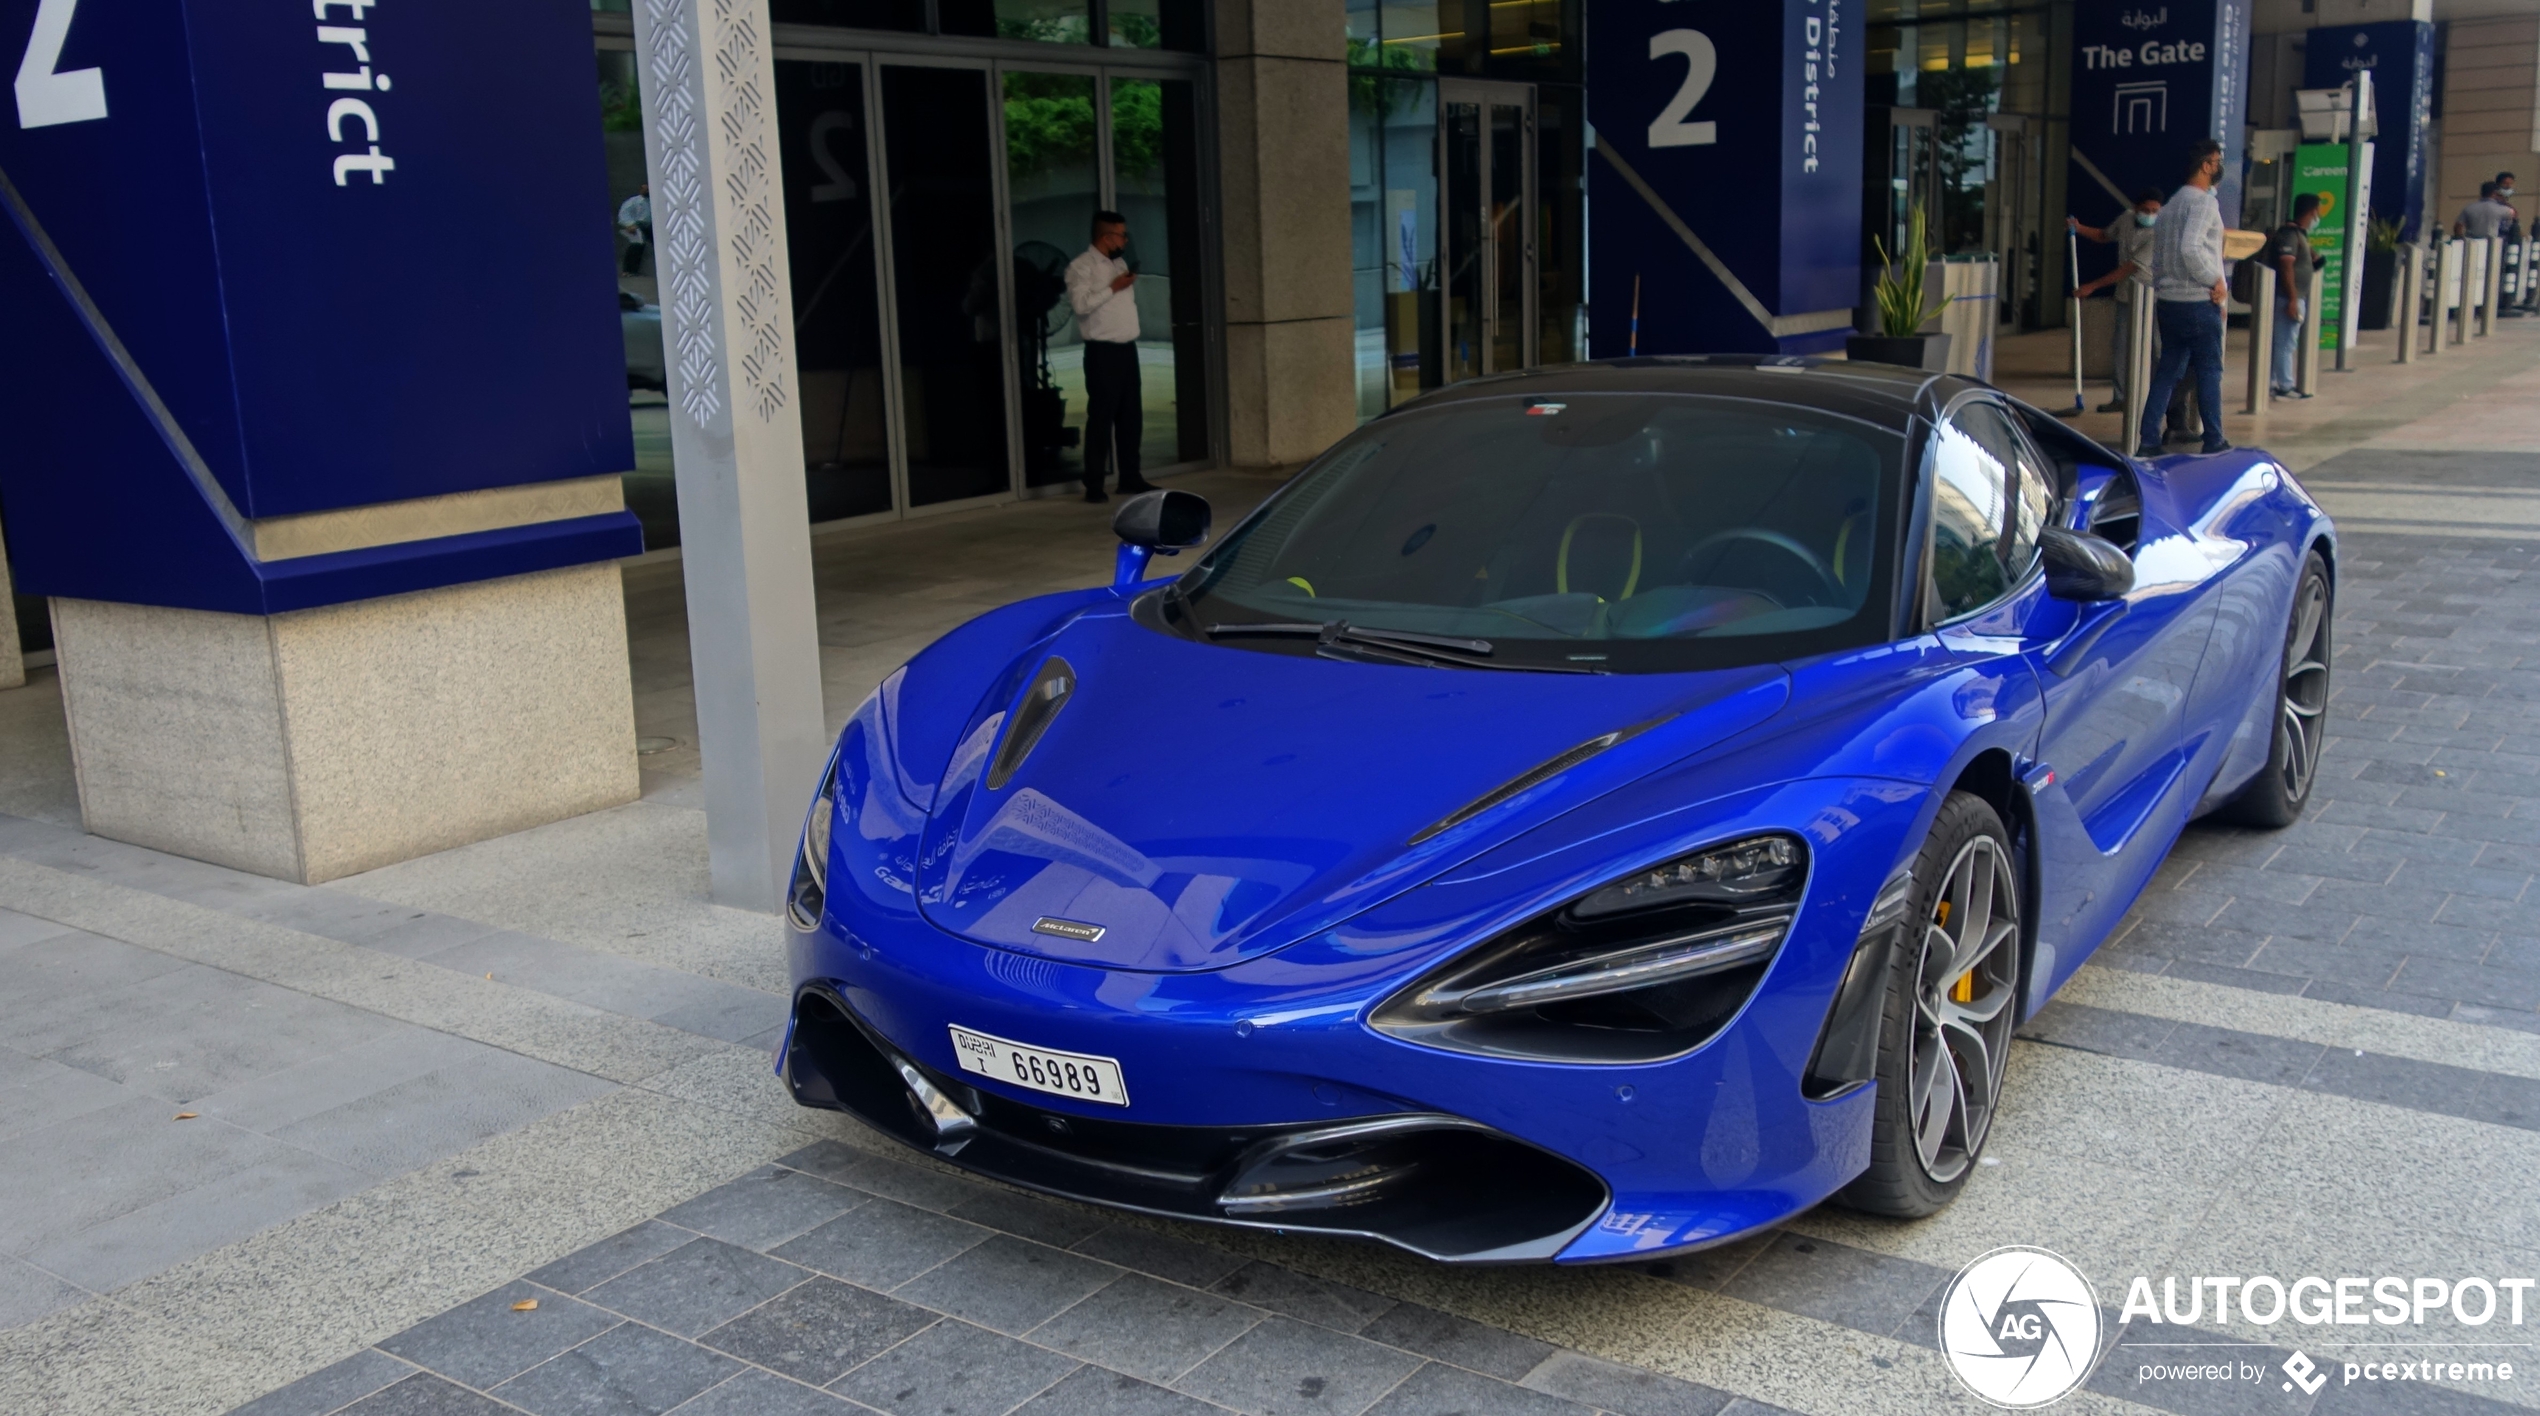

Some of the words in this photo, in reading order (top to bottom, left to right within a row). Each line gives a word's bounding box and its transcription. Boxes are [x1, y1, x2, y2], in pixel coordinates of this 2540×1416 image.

[2121, 6, 2168, 31] البوابة
[2082, 45, 2133, 70] The
[2140, 39, 2206, 66] Gate
[1647, 28, 1717, 149] 2
[1803, 16, 1822, 174] District
[1039, 922, 1091, 936] McLaren
[1011, 1051, 1101, 1096] 66989
